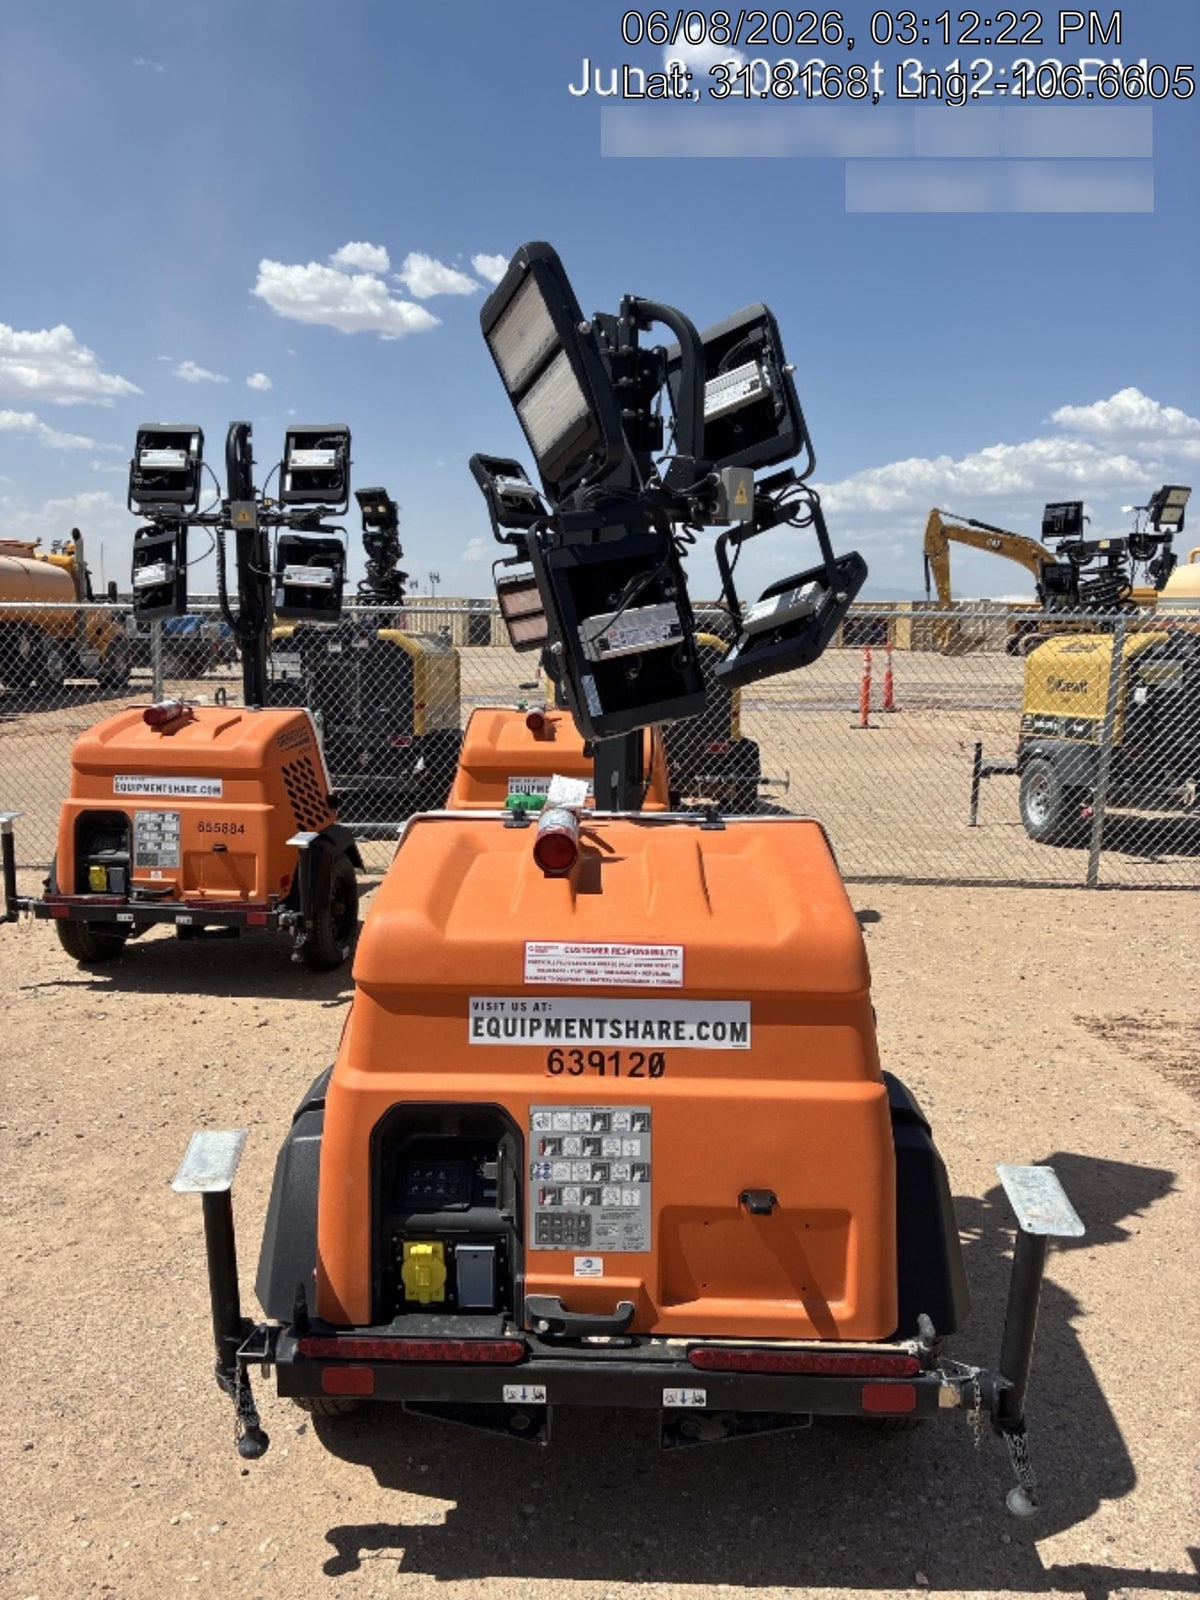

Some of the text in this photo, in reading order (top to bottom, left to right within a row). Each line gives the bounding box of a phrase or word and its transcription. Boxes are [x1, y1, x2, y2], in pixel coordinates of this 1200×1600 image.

[115, 782, 222, 796] EQUIPMENTSHARE.COM
[564, 945, 609, 954] CUSTOMER
[472, 1001, 553, 1013] VISIT US AT:
[473, 1017, 747, 1042] EQUIPMENTSHARE.COM
[546, 1048, 667, 1079] 639120
